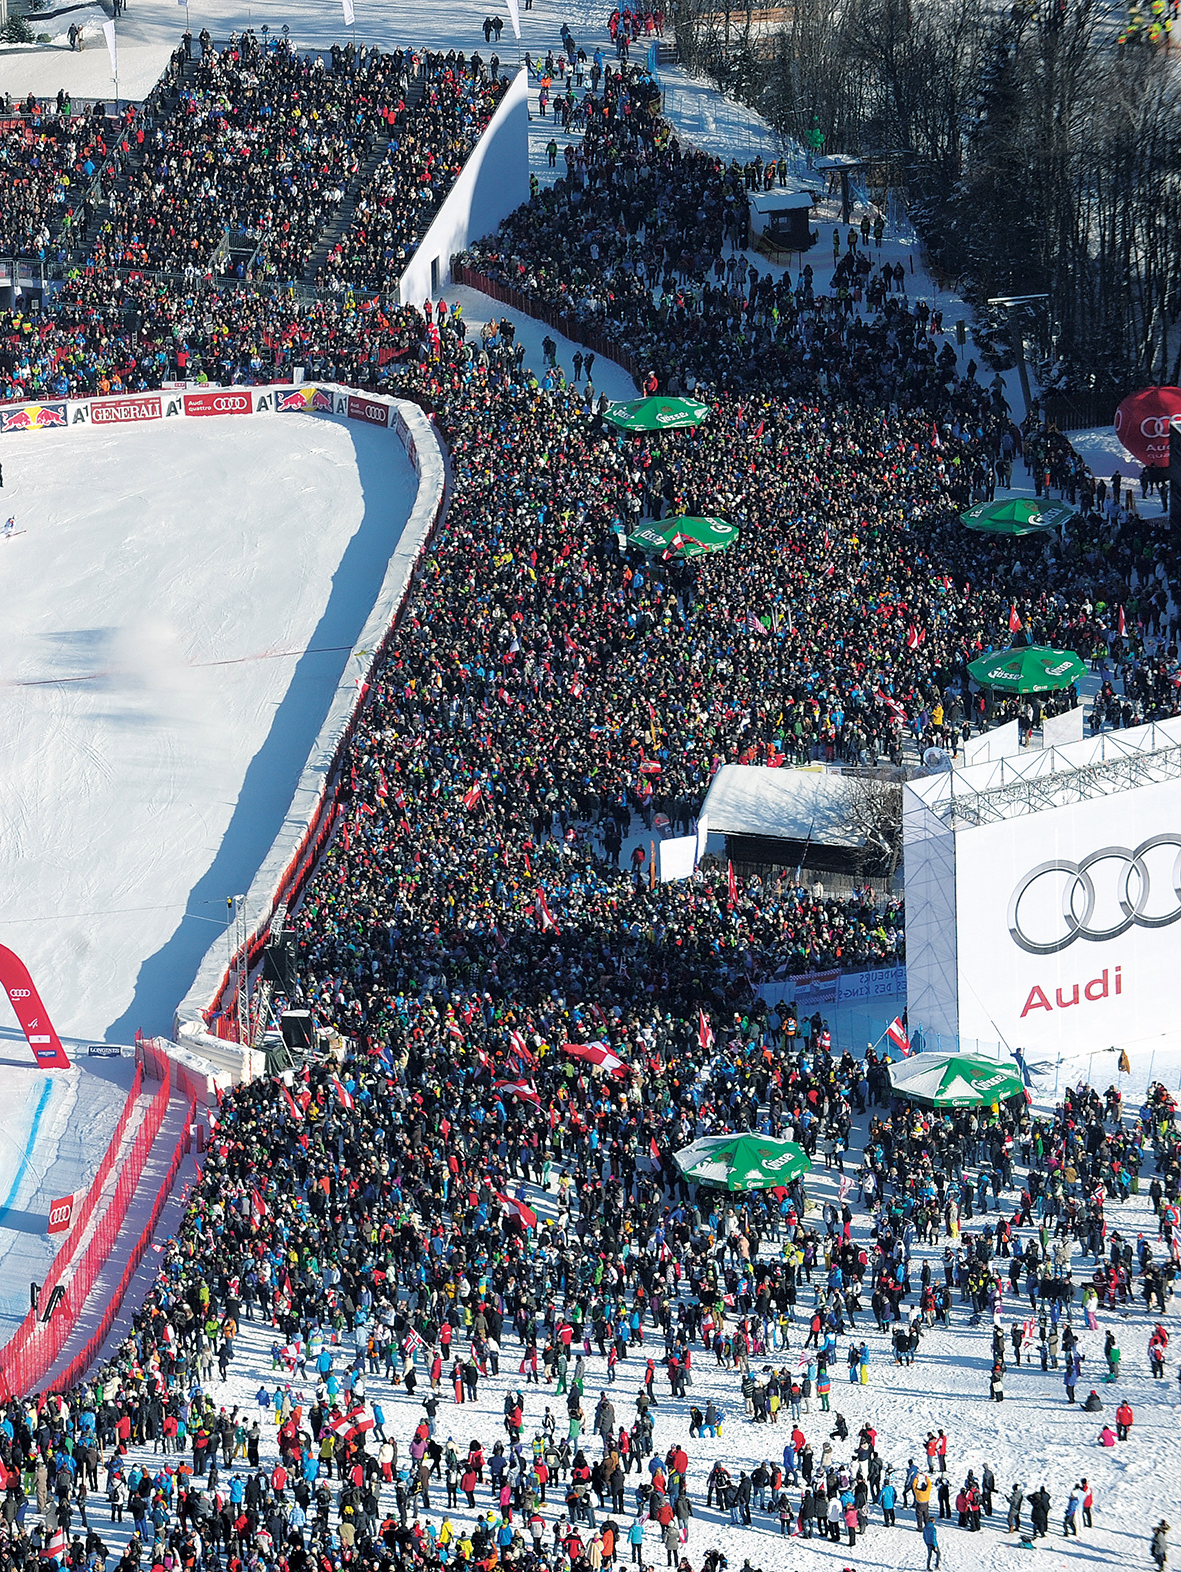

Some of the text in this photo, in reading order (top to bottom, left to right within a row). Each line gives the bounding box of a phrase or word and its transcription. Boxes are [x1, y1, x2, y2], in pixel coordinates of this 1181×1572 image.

[166, 398, 182, 417] A1
[257, 393, 273, 412] A1
[72, 405, 89, 424] A1
[92, 403, 161, 422] GENERALI
[1145, 444, 1170, 452] Au
[1020, 965, 1122, 1018] Audi
[89, 1047, 120, 1055] LONGINES
